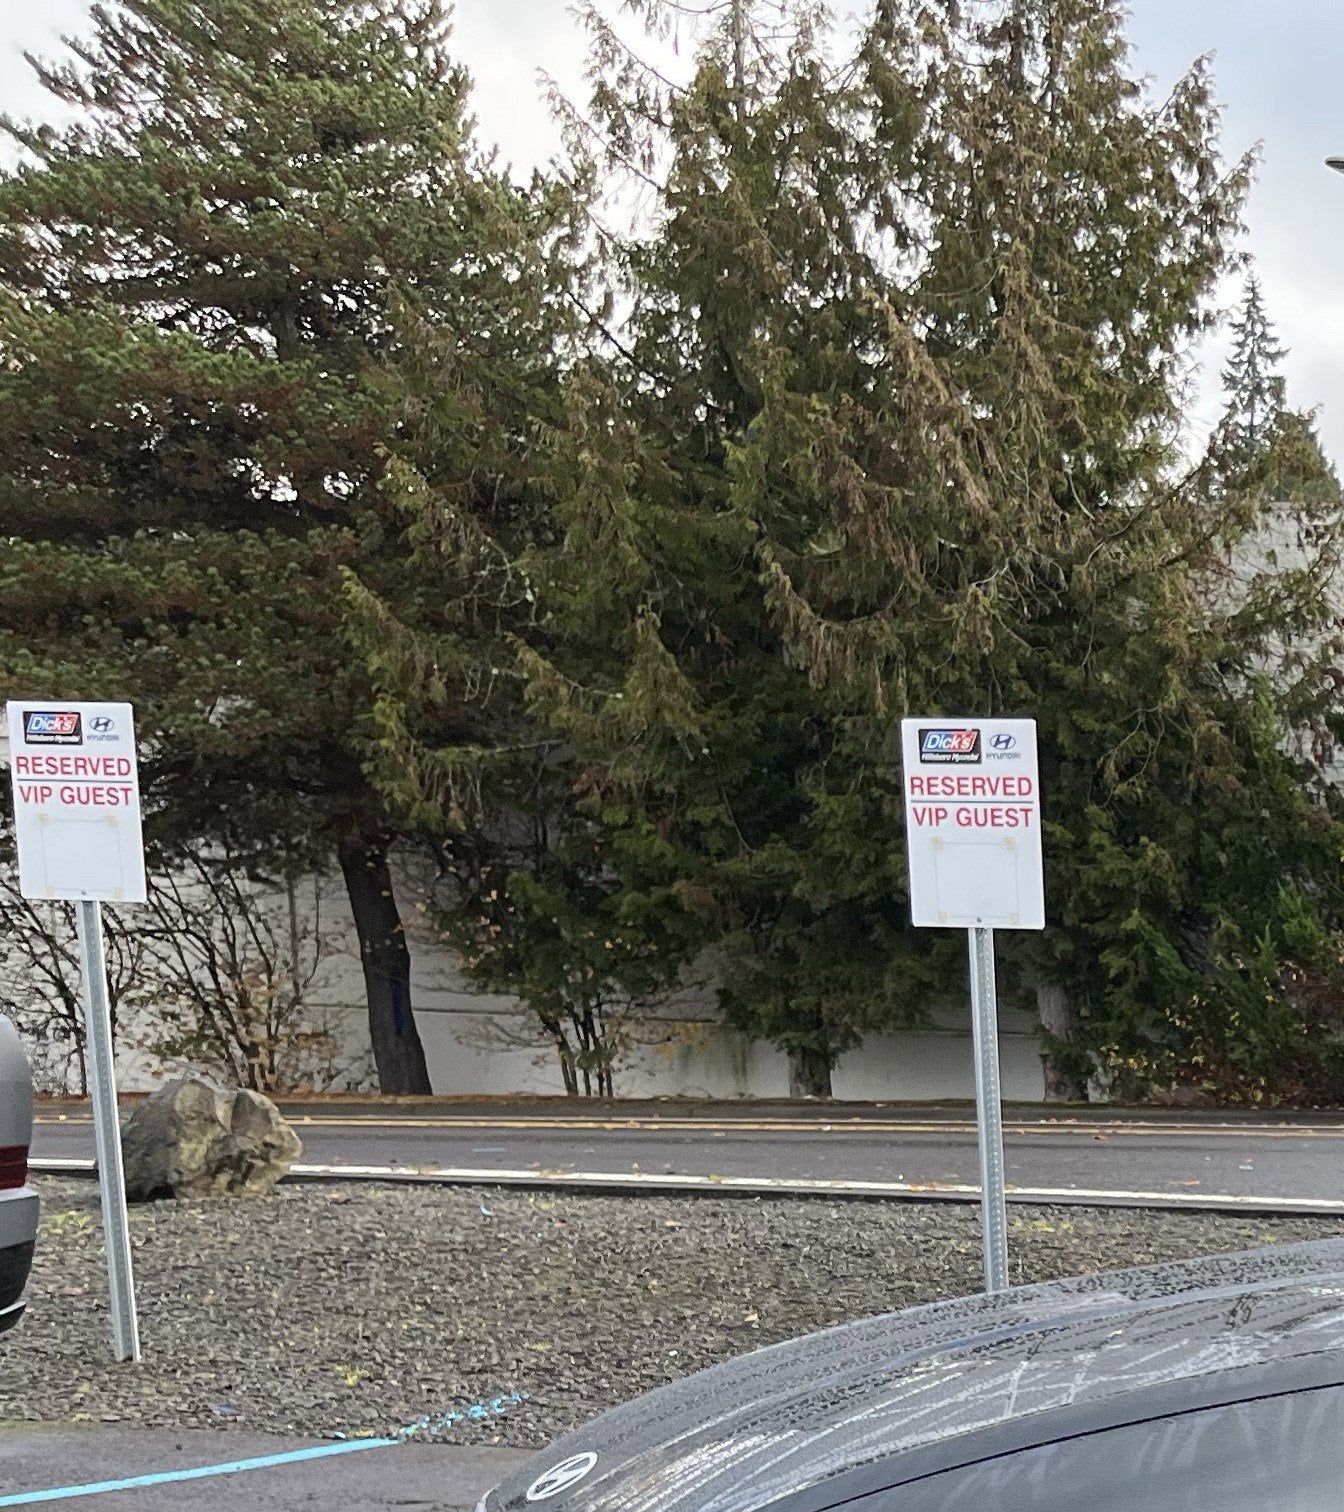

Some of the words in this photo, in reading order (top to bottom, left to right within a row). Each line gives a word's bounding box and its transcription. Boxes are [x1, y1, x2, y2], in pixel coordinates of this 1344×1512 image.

[16, 756, 131, 776] RESERVED
[19, 785, 53, 804] VIP
[60, 786, 133, 806] GUEST
[910, 776, 1033, 796] RESERVED
[913, 807, 948, 826] VIP
[956, 808, 1033, 827] GUEST
